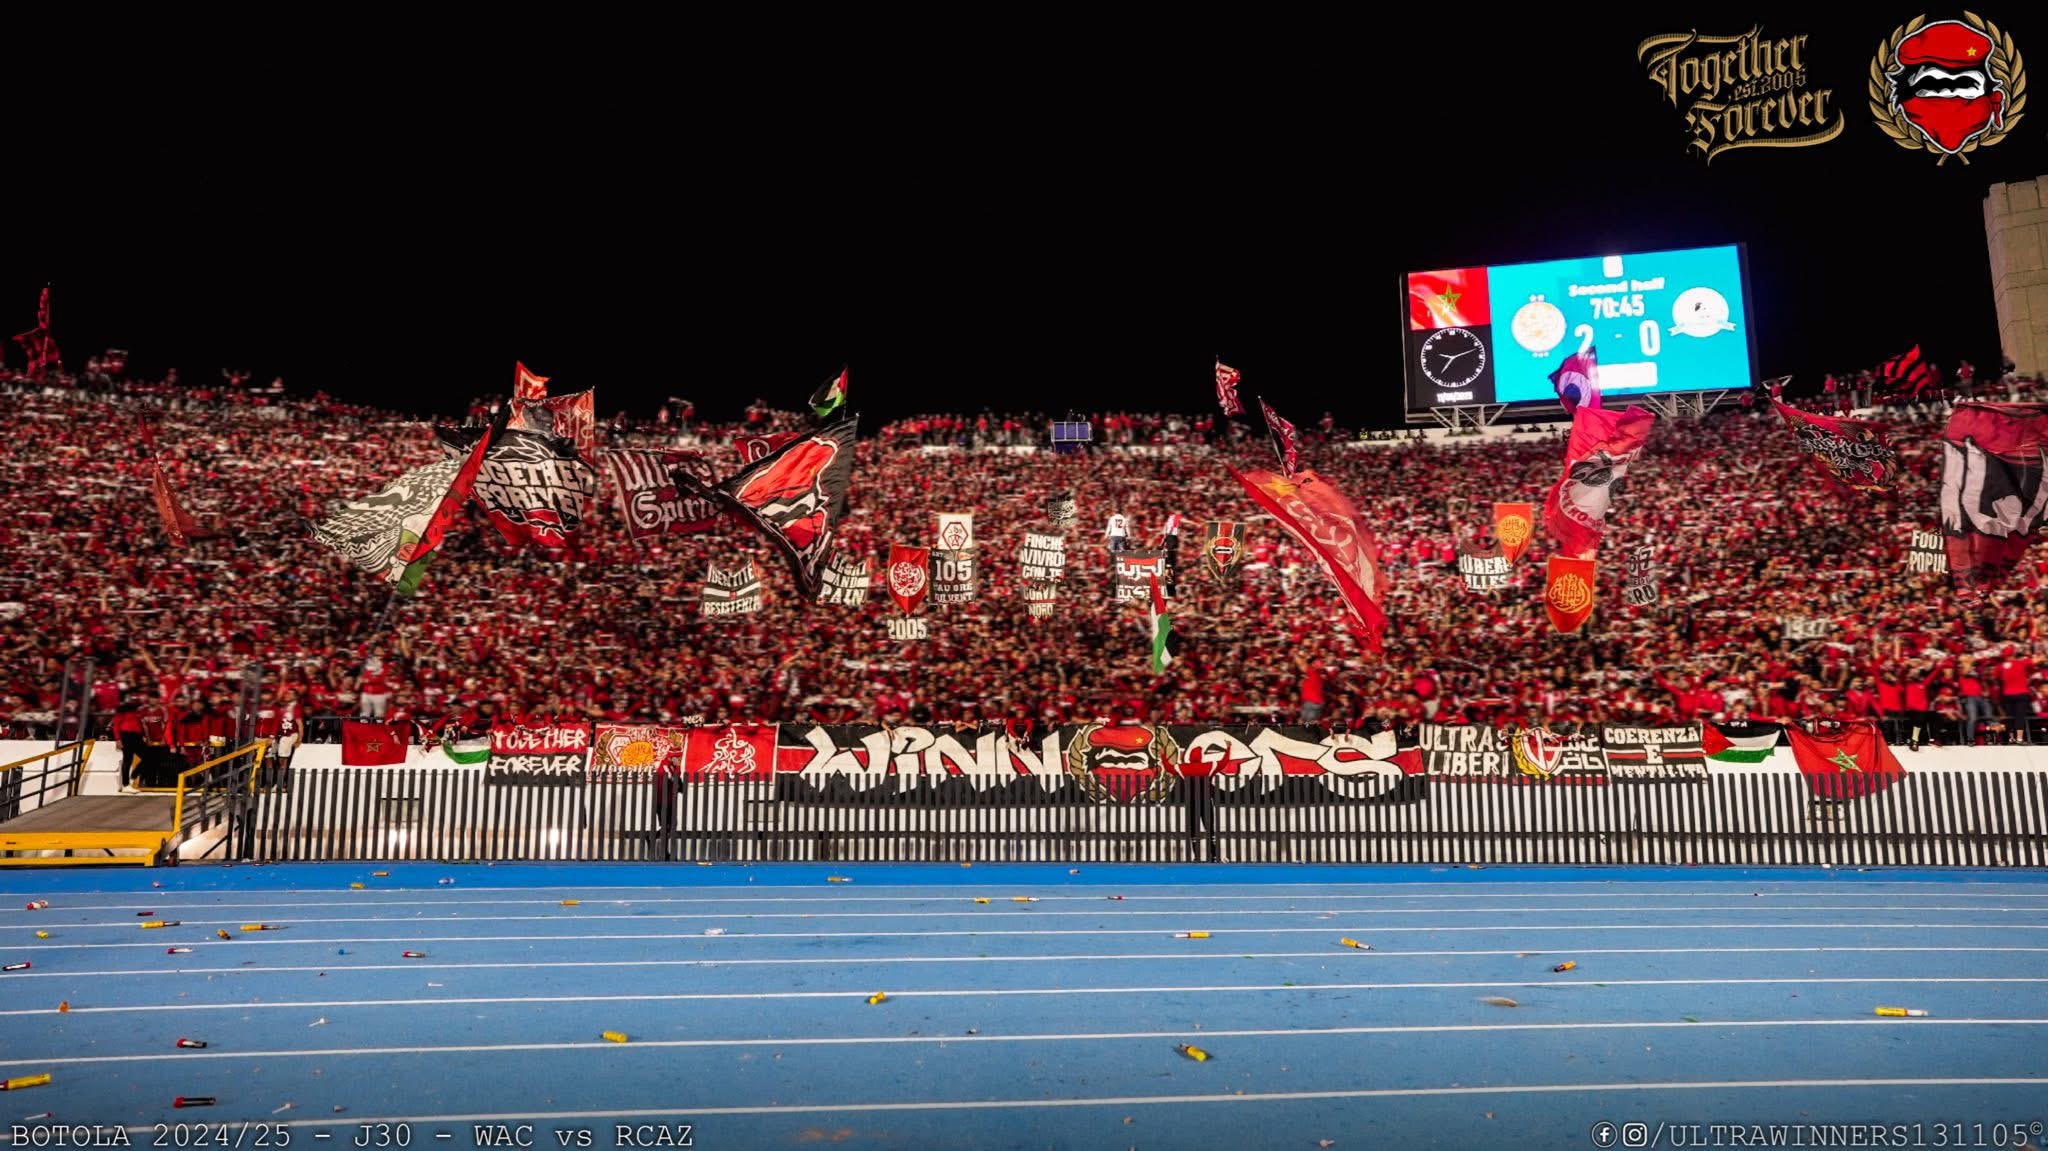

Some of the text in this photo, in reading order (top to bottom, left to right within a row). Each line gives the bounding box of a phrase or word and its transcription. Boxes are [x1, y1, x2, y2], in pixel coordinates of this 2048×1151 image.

[1590, 294, 1645, 319] 70:45
[1574, 324, 1594, 357] 2
[1639, 319, 1661, 356] 0
[935, 560, 972, 581] 105
[887, 618, 928, 640] 2005
[1419, 723, 1510, 752] ULTRAS
[1604, 727, 1700, 744] COERENZA
[487, 754, 583, 777] FOREVER
[1427, 751, 1510, 777] LIBERI
[1645, 745, 1663, 764] E
